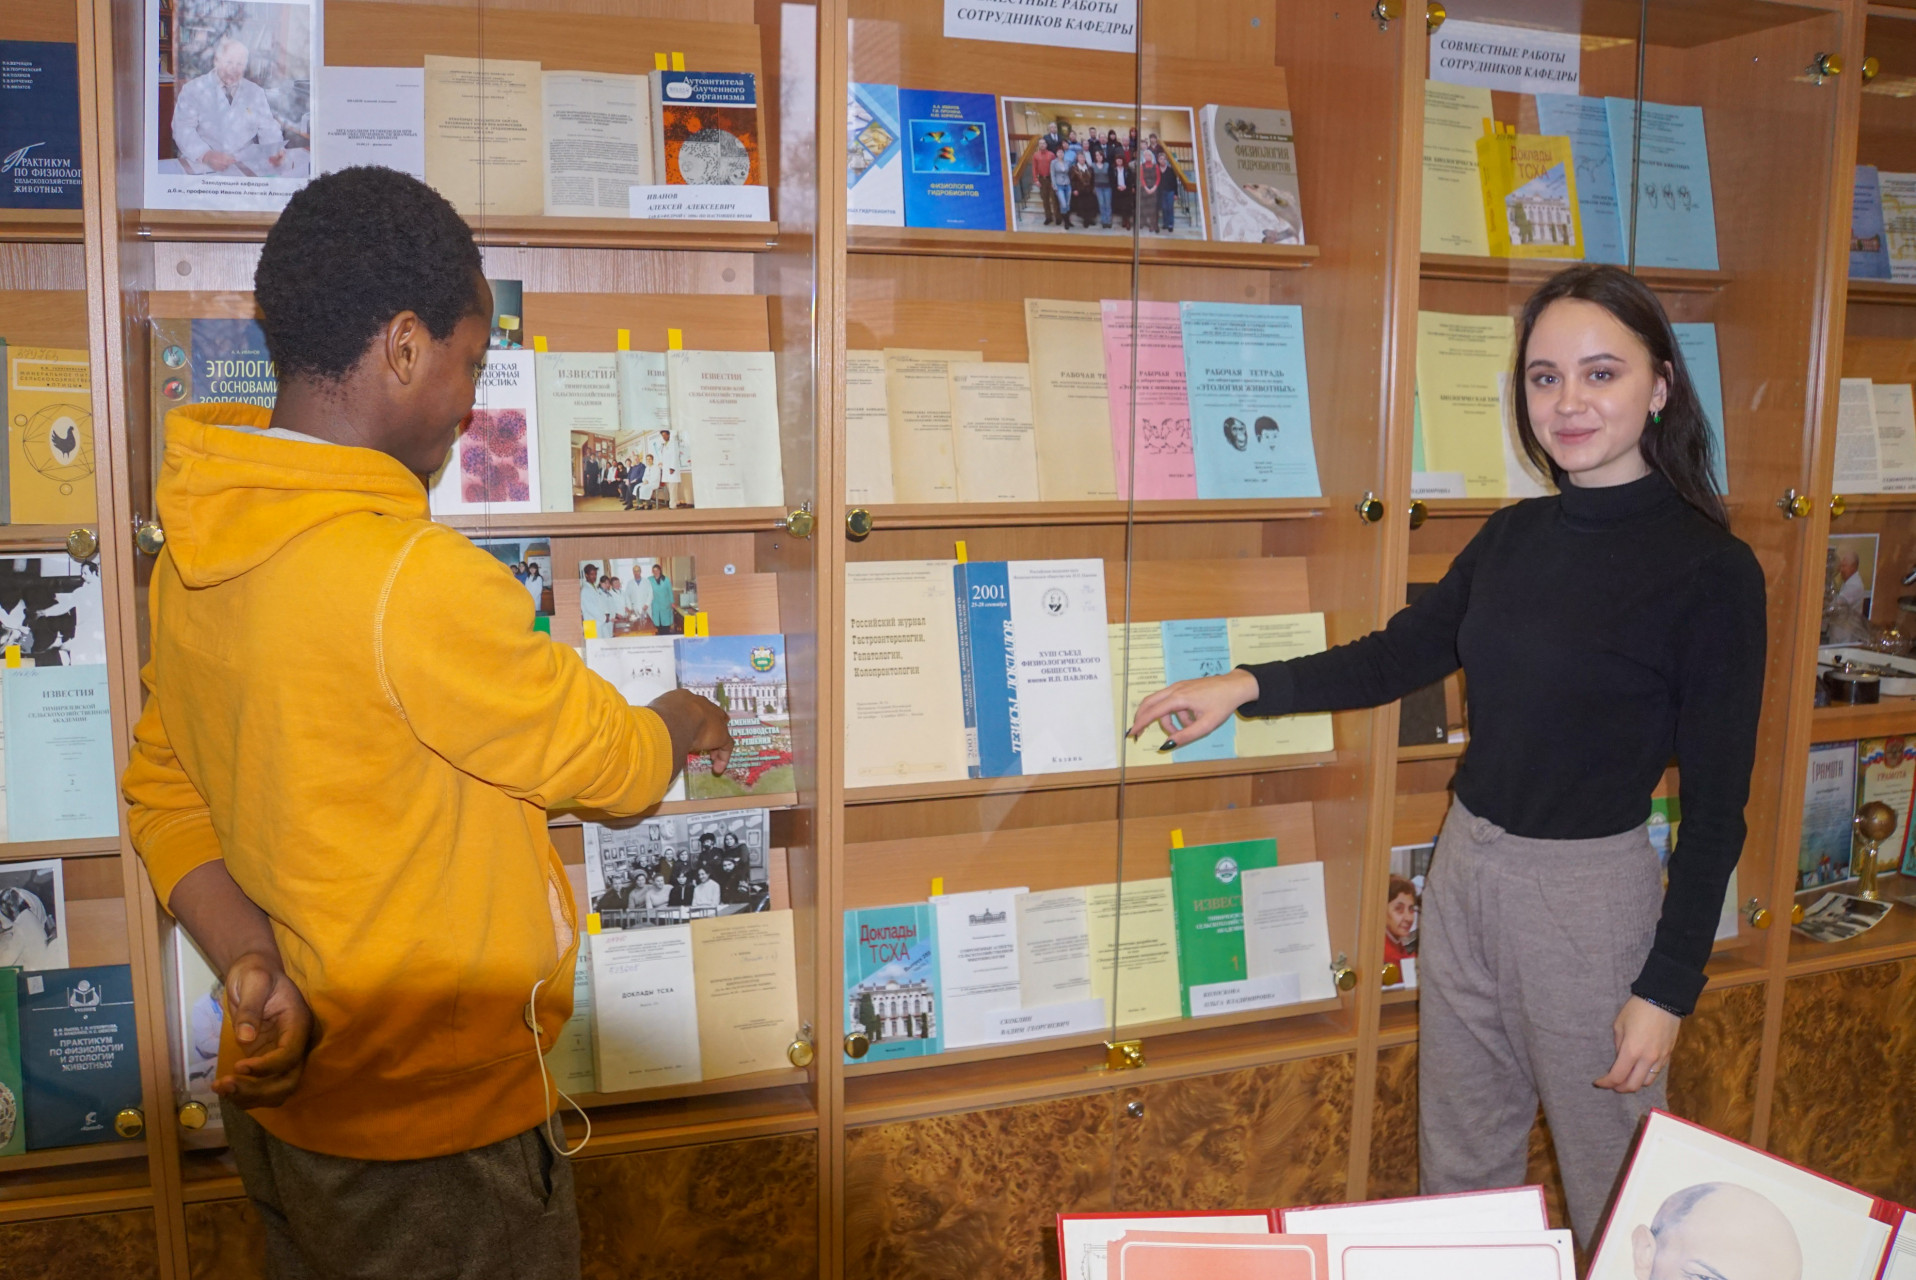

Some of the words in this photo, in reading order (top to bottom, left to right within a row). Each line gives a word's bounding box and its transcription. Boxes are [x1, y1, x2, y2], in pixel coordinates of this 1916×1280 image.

[1062, 0, 1119, 14] РАБОТЫ
[957, 7, 1062, 28] СОТРУДНИКОВ
[1065, 18, 1134, 36] КАФЕДРЫ
[1440, 38, 1519, 58] СОВМЕСТНЫЕ
[1521, 48, 1566, 64] РАБОТЫ
[1440, 57, 1522, 76] СОТРУДНИКОВ
[1524, 67, 1578, 82] КАФЕДРЫ
[684, 76, 744, 86] Аутоантитела
[691, 85, 746, 94] блученного
[696, 94, 746, 102] организма
[1235, 144, 1289, 160] ФИЗИОЛОГИЯ
[1510, 145, 1552, 163] Доклады
[14, 168, 28, 176] ПО
[1518, 163, 1550, 180] ТСХА
[206, 360, 279, 378] ЭТОЛОГИ
[558, 369, 616, 380] ИЗВЕСТИЯ
[1205, 368, 1242, 376] РАБОЧАЯ
[702, 372, 742, 380] ИЗВЕСТИЯ
[211, 381, 217, 393] С
[972, 585, 1005, 600] 2001
[851, 617, 896, 628] Российский
[897, 617, 926, 628] журнал
[1021, 657, 1101, 667] ФИЗИОЛОГИЧЕСКОГО
[854, 666, 920, 678] Колопроктологии
[1063, 674, 1098, 682] ПАВЛОВА
[42, 688, 94, 698] ИЗВЕСТИЯ
[860, 924, 917, 945] Доклады
[869, 942, 910, 964] ТСХА
[1232, 955, 1239, 971] 1
[622, 990, 654, 998] ДОКЛАДЫ
[60, 1036, 112, 1047] ПРАКТИКУМ
[64, 1044, 124, 1055] ФИЗИОЛОГИИ
[68, 1052, 114, 1063] ЭТОЛОГИИ
[62, 1061, 112, 1072] ЖИВОТНЫХ
